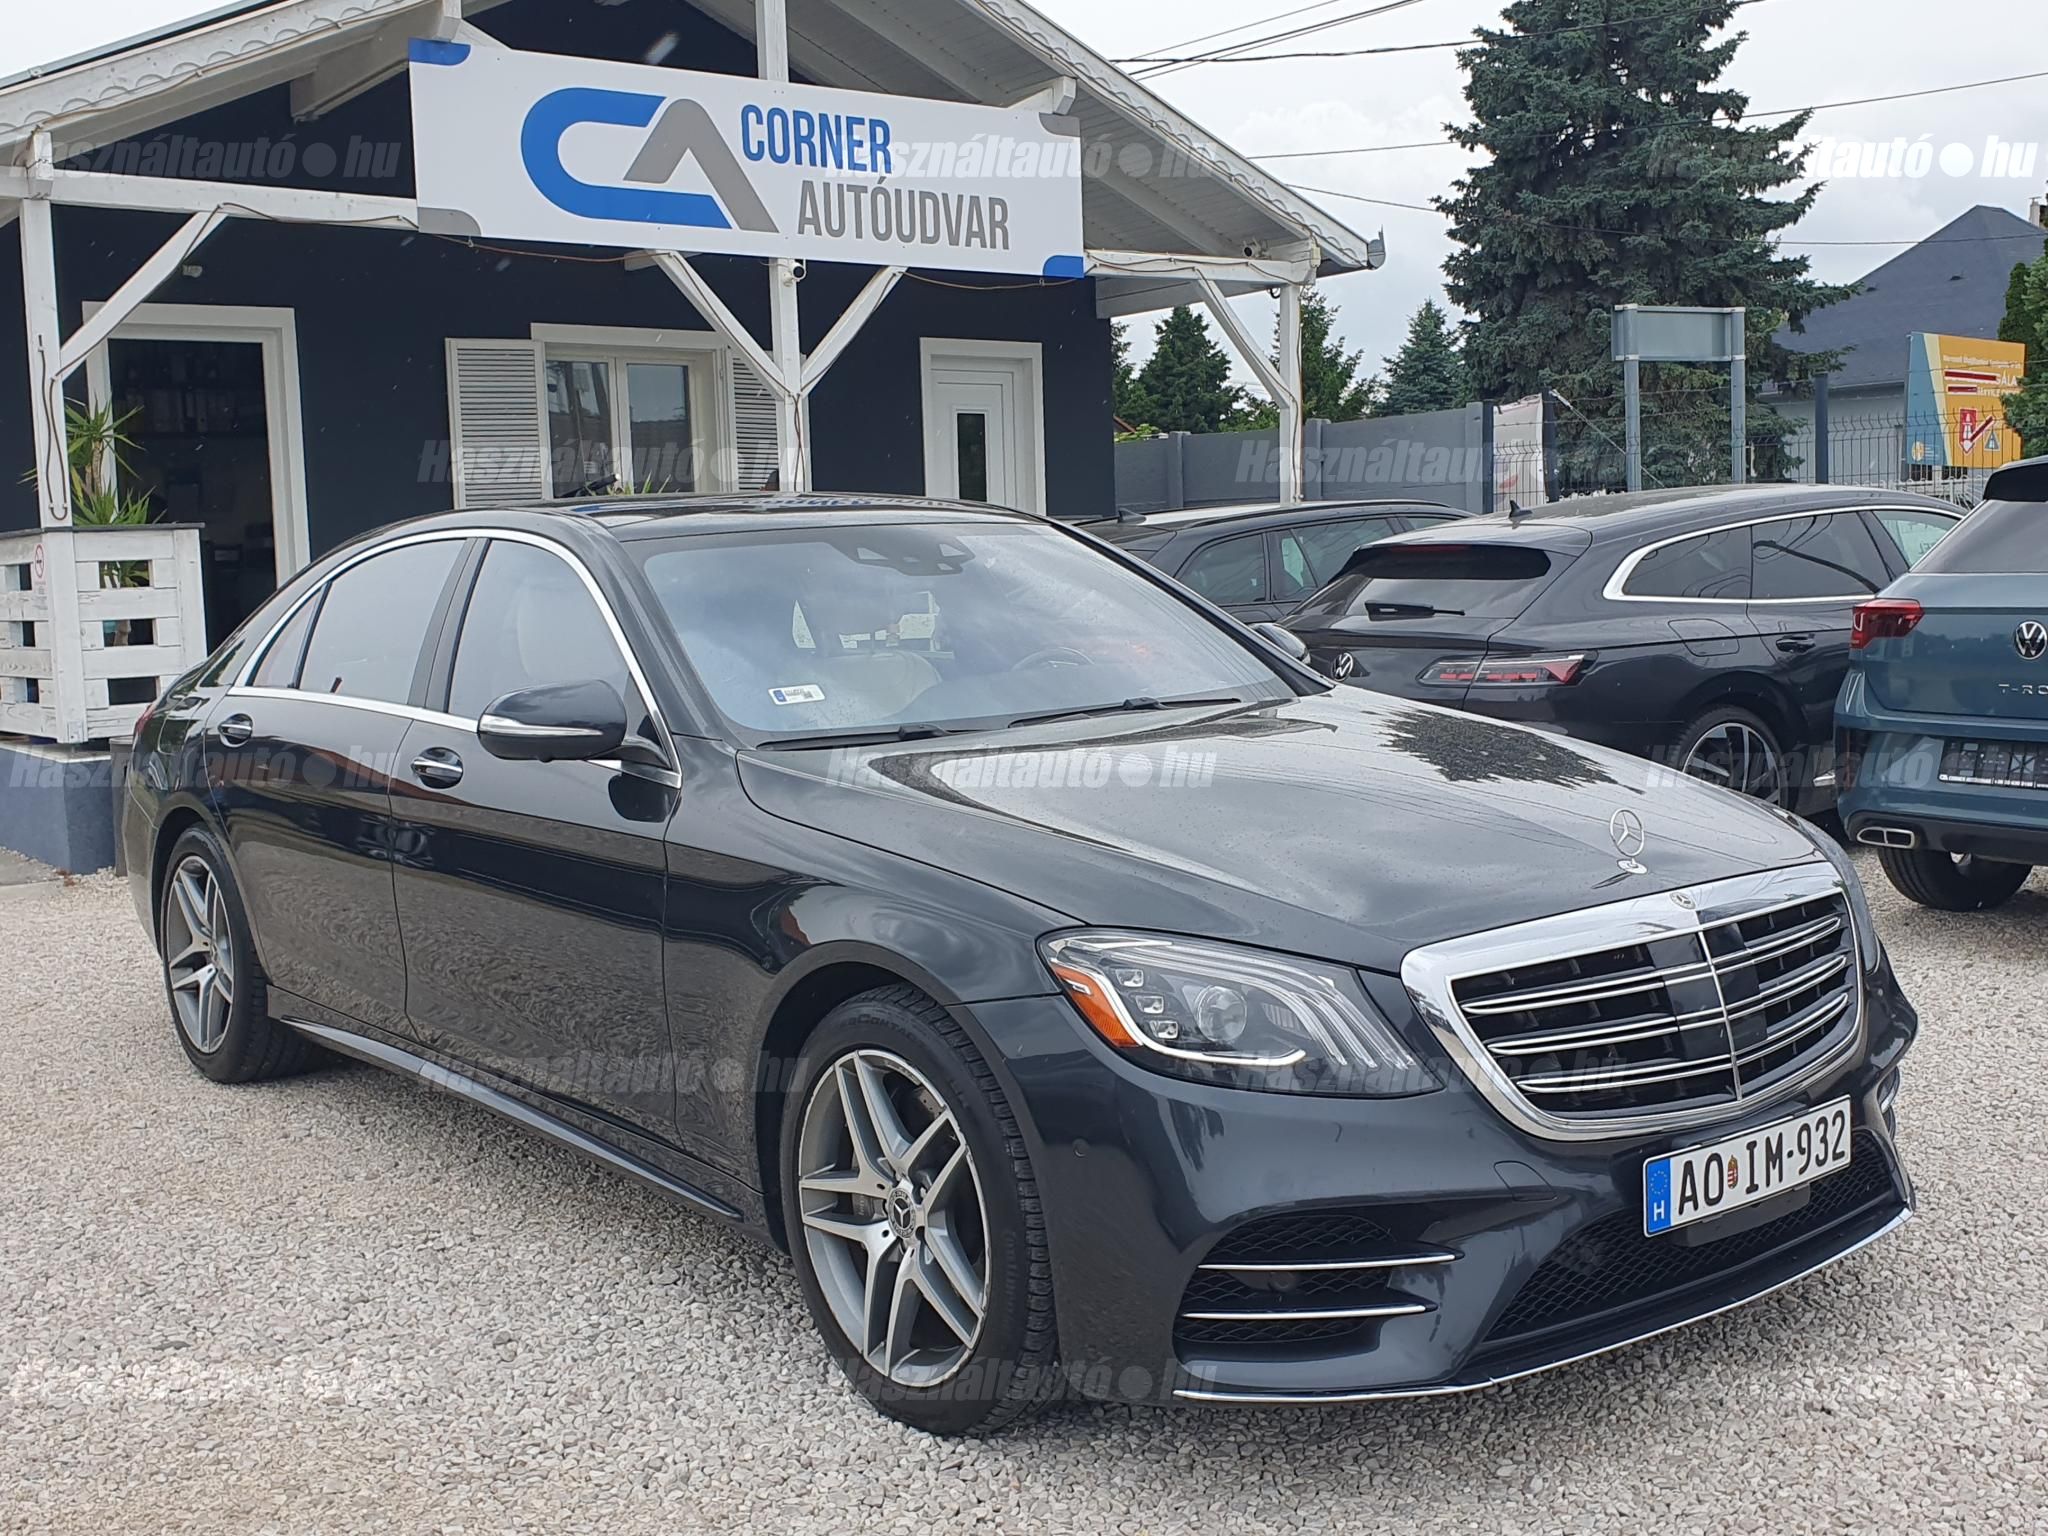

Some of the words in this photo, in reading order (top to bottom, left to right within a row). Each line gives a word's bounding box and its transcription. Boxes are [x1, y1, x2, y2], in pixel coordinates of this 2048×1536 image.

[741, 104, 893, 174] CORNER
[797, 176, 1010, 250] AUTÓUDVAR
[1678, 1153, 1724, 1215] AO
[1745, 1110, 1846, 1195] IM-932
[1653, 1201, 1665, 1222] H
